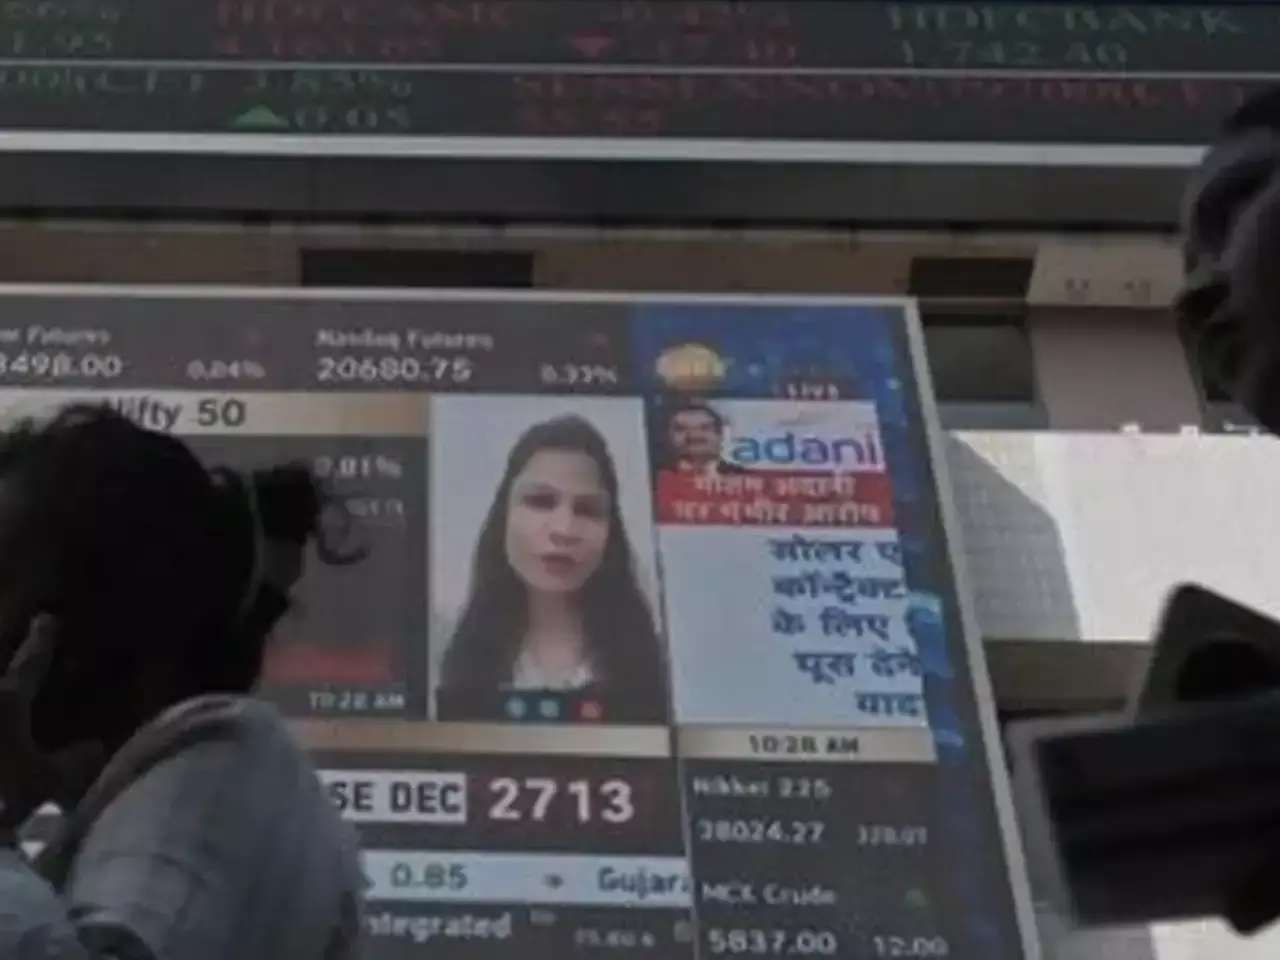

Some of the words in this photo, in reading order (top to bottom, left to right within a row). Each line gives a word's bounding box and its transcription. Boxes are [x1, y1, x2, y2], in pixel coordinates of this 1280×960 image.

[886, 3, 1247, 35] HDFCBANK
[197, 397, 247, 428] 50
[731, 431, 879, 466] adani
[826, 735, 860, 754] AM
[329, 780, 374, 814] SE
[389, 781, 462, 814] DEC
[487, 776, 636, 823] 2713
[368, 910, 513, 943] ntegrated
